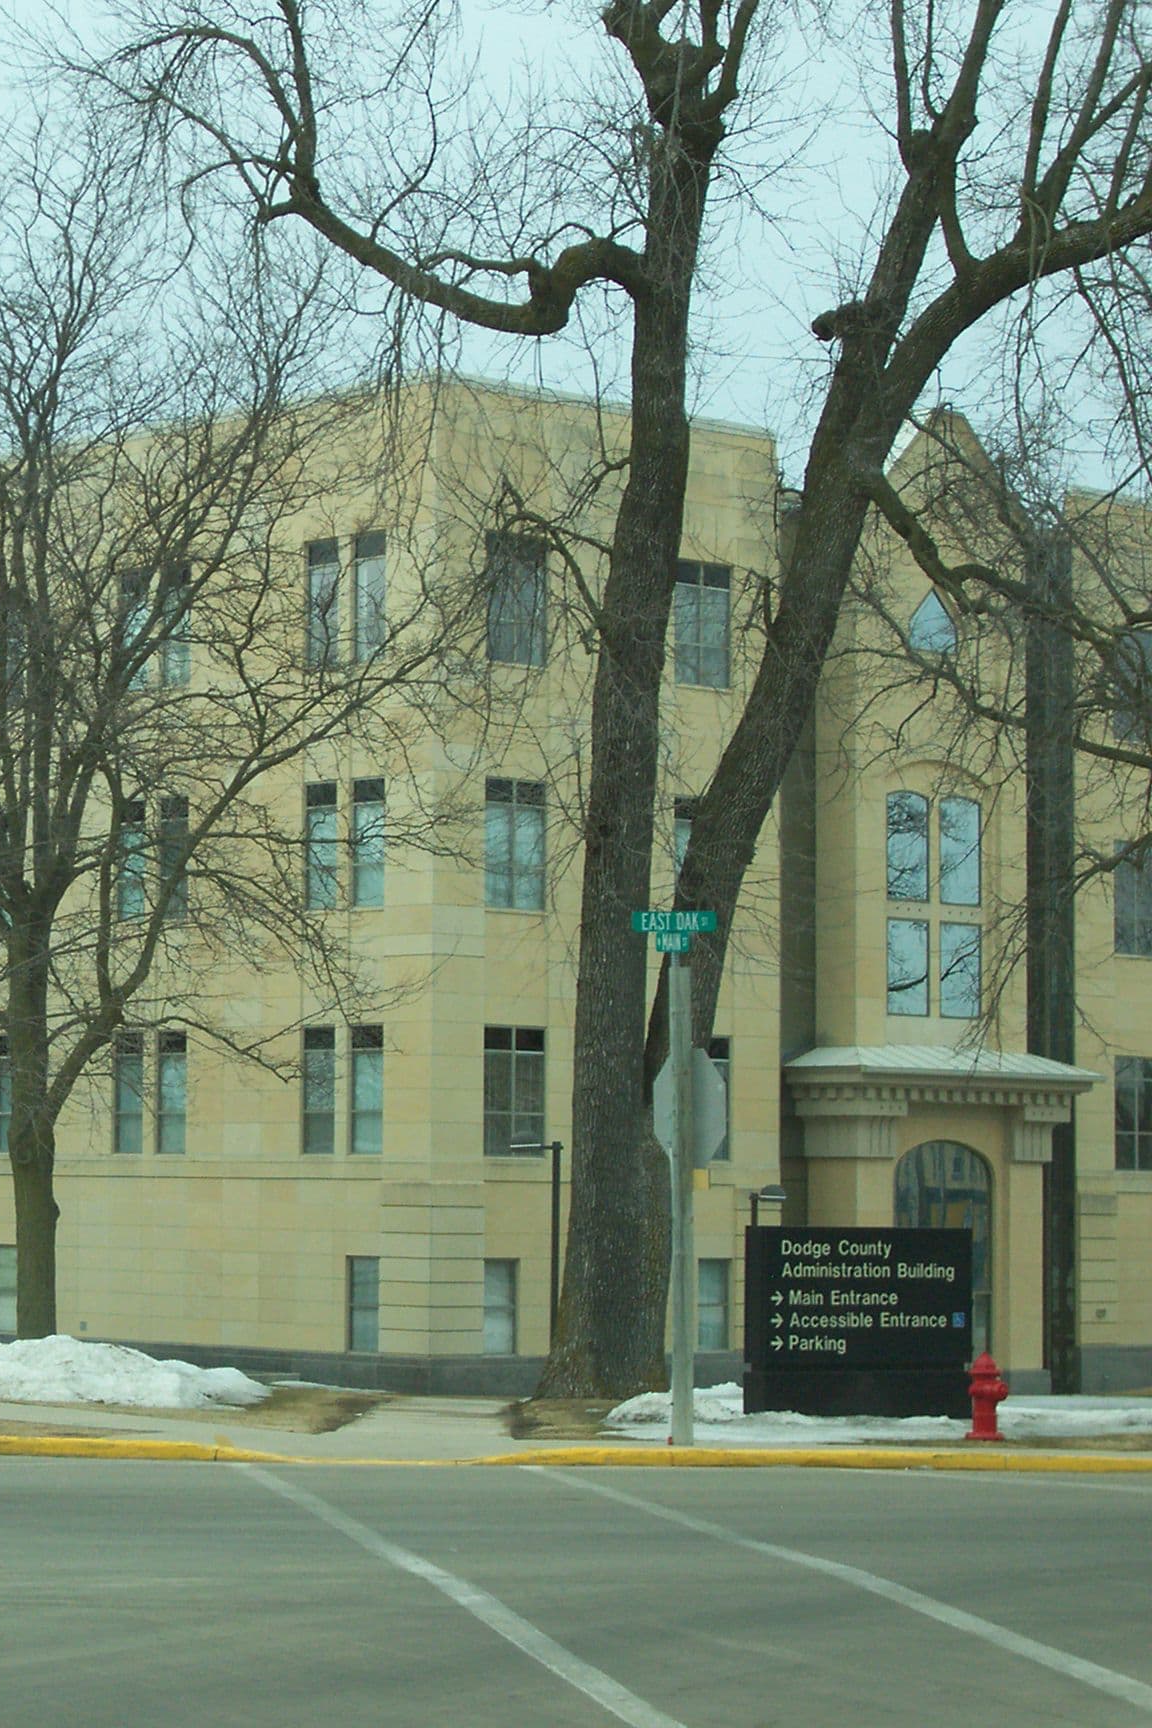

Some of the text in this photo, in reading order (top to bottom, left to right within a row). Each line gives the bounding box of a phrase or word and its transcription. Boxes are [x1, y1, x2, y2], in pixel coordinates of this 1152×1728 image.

[641, 912, 671, 931] EAST
[676, 912, 699, 931] OAK
[781, 1239, 892, 1259] Dodge County
[782, 1262, 955, 1282] Administration Building
[788, 1290, 898, 1305] Main Entrance
[789, 1312, 947, 1328] Accessible Entrance
[788, 1335, 846, 1354] Parking
